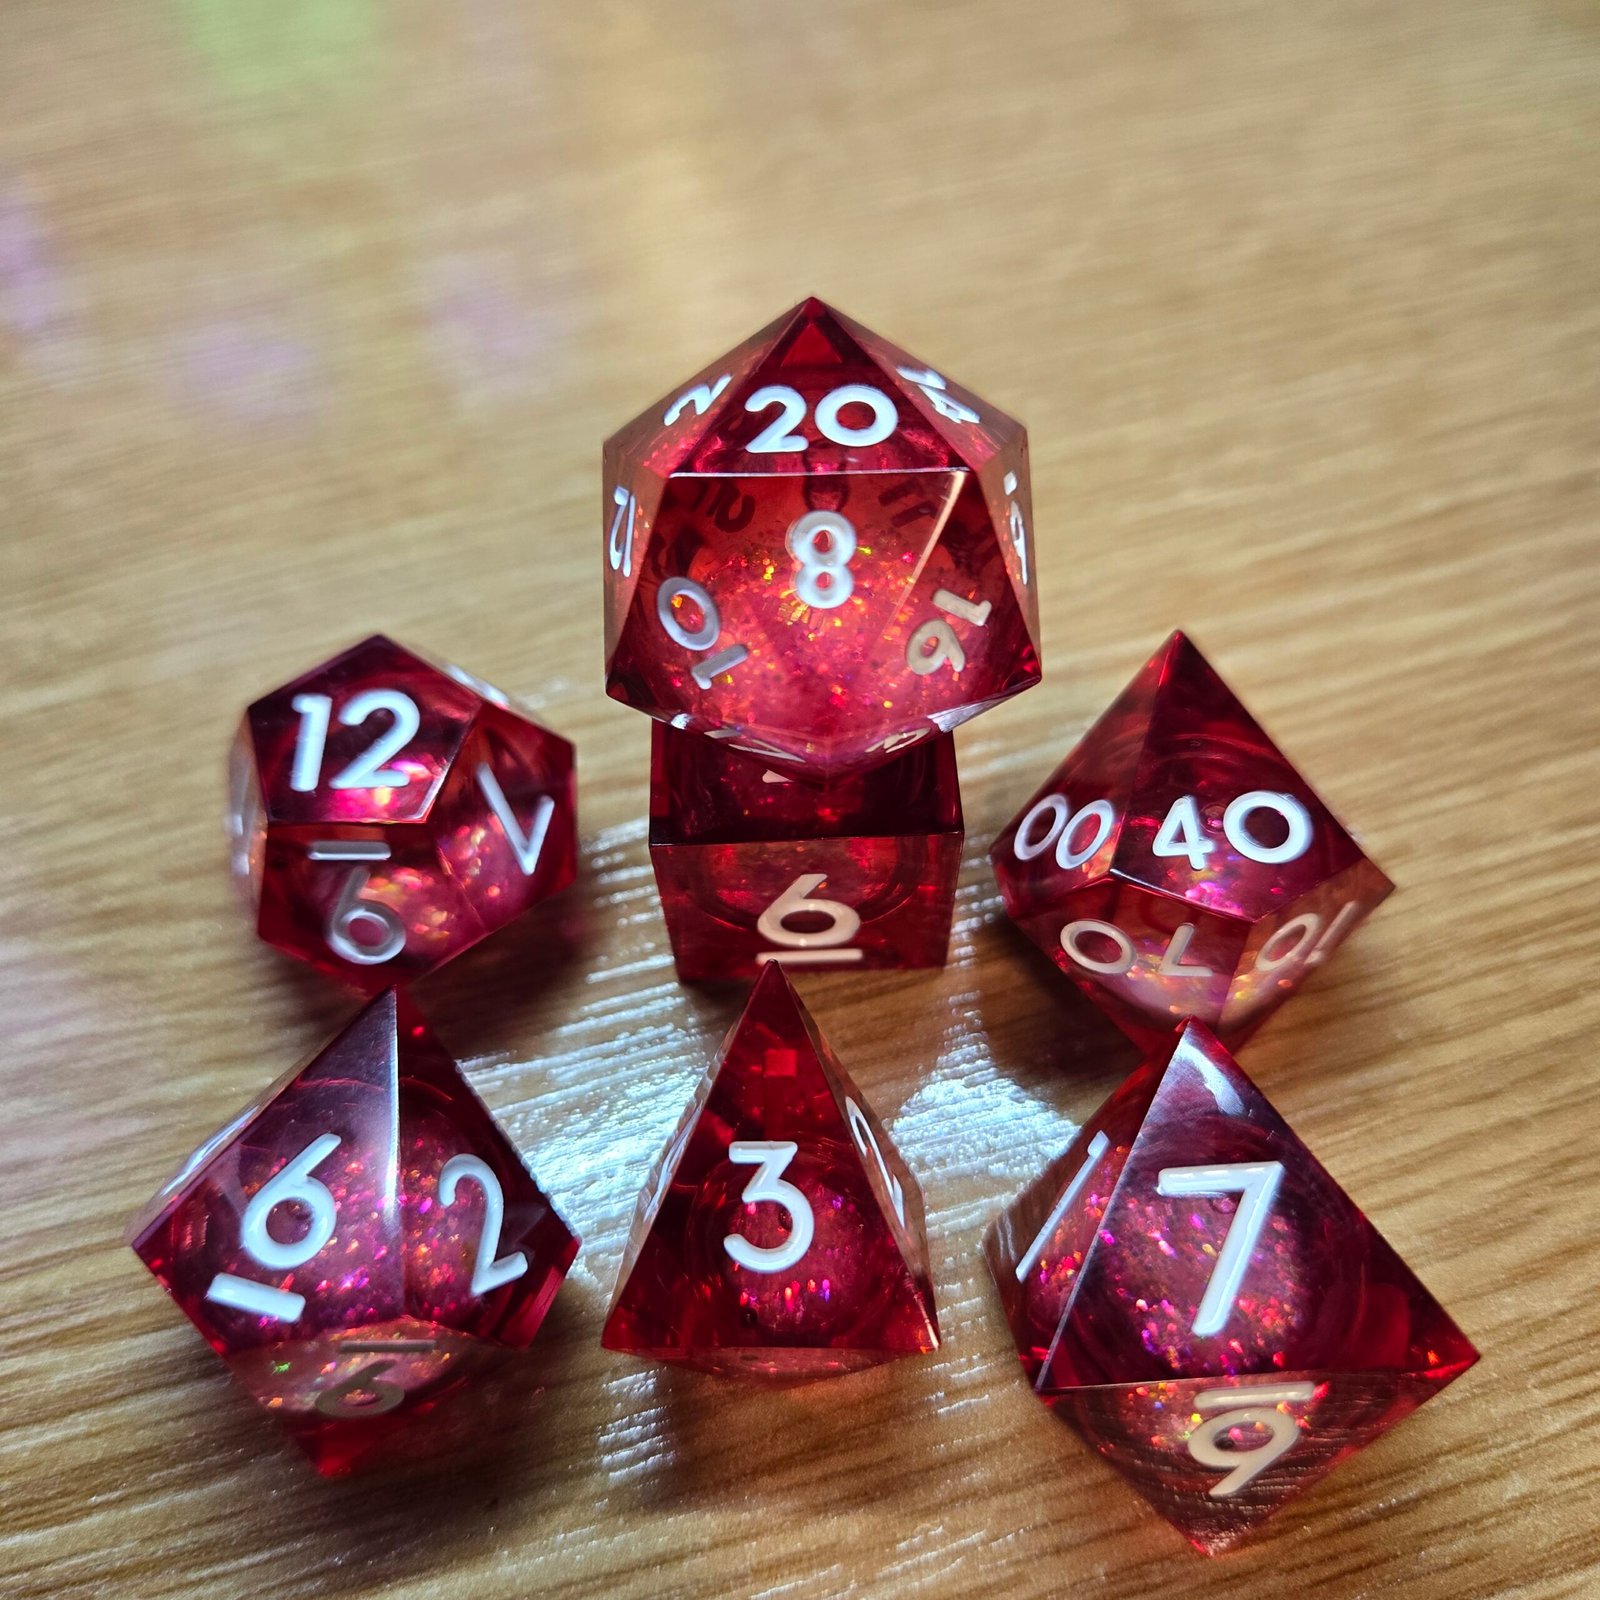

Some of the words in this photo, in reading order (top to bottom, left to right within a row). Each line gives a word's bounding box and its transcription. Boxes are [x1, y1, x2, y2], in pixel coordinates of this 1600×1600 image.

[663, 373, 733, 427] 2
[744, 384, 899, 454] 20
[785, 510, 857, 609] 8
[657, 577, 748, 690] 10
[906, 588, 992, 676] 16
[290, 688, 420, 792] 12
[1013, 793, 1115, 869] 00
[1152, 790, 1314, 871] 40
[756, 873, 863, 965] 6
[1060, 919, 1213, 977] 70
[205, 1132, 342, 1323] 6
[438, 1152, 529, 1298] 2
[723, 1141, 814, 1273] 3
[1015, 1130, 1110, 1283] 1
[1157, 1161, 1285, 1336] 7
